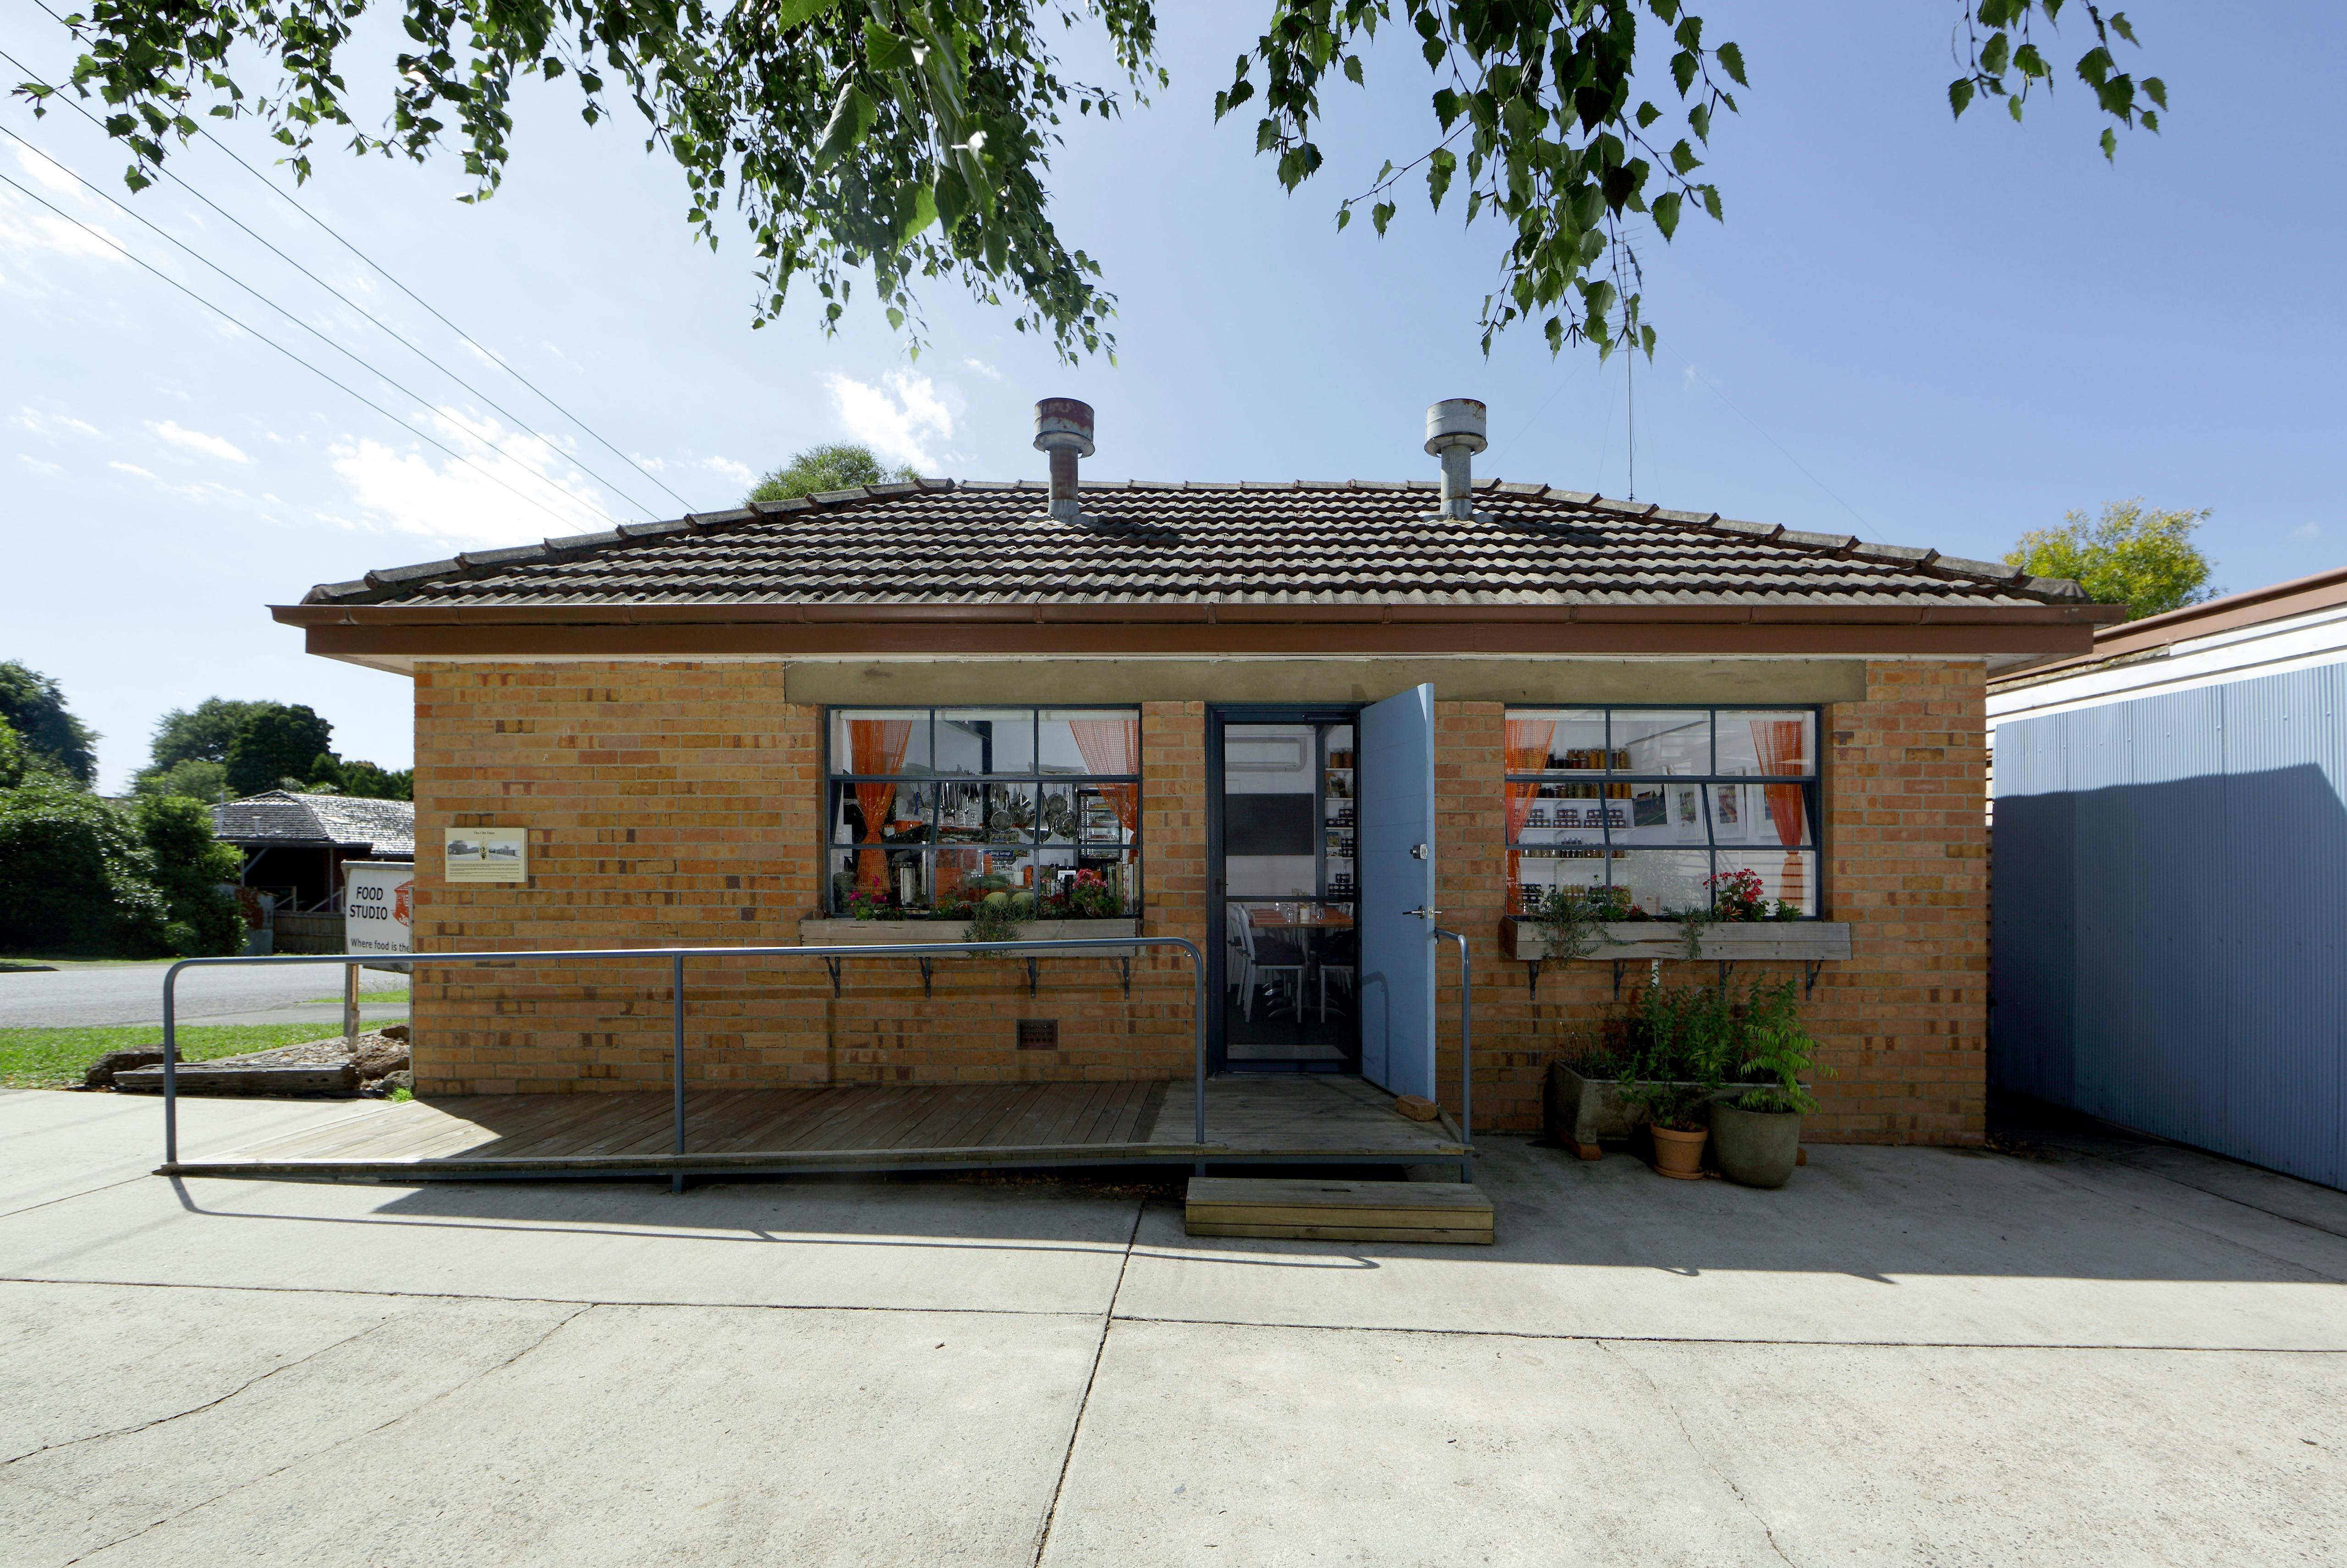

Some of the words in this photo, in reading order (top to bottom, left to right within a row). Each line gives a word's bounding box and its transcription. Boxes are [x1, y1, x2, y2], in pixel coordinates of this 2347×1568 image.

[356, 887, 383, 900] FOOD
[349, 904, 387, 920] STUDIO
[351, 938, 372, 948] Where
[374, 940, 389, 950] food
[391, 942, 397, 951] is
[399, 943, 409, 953] the
